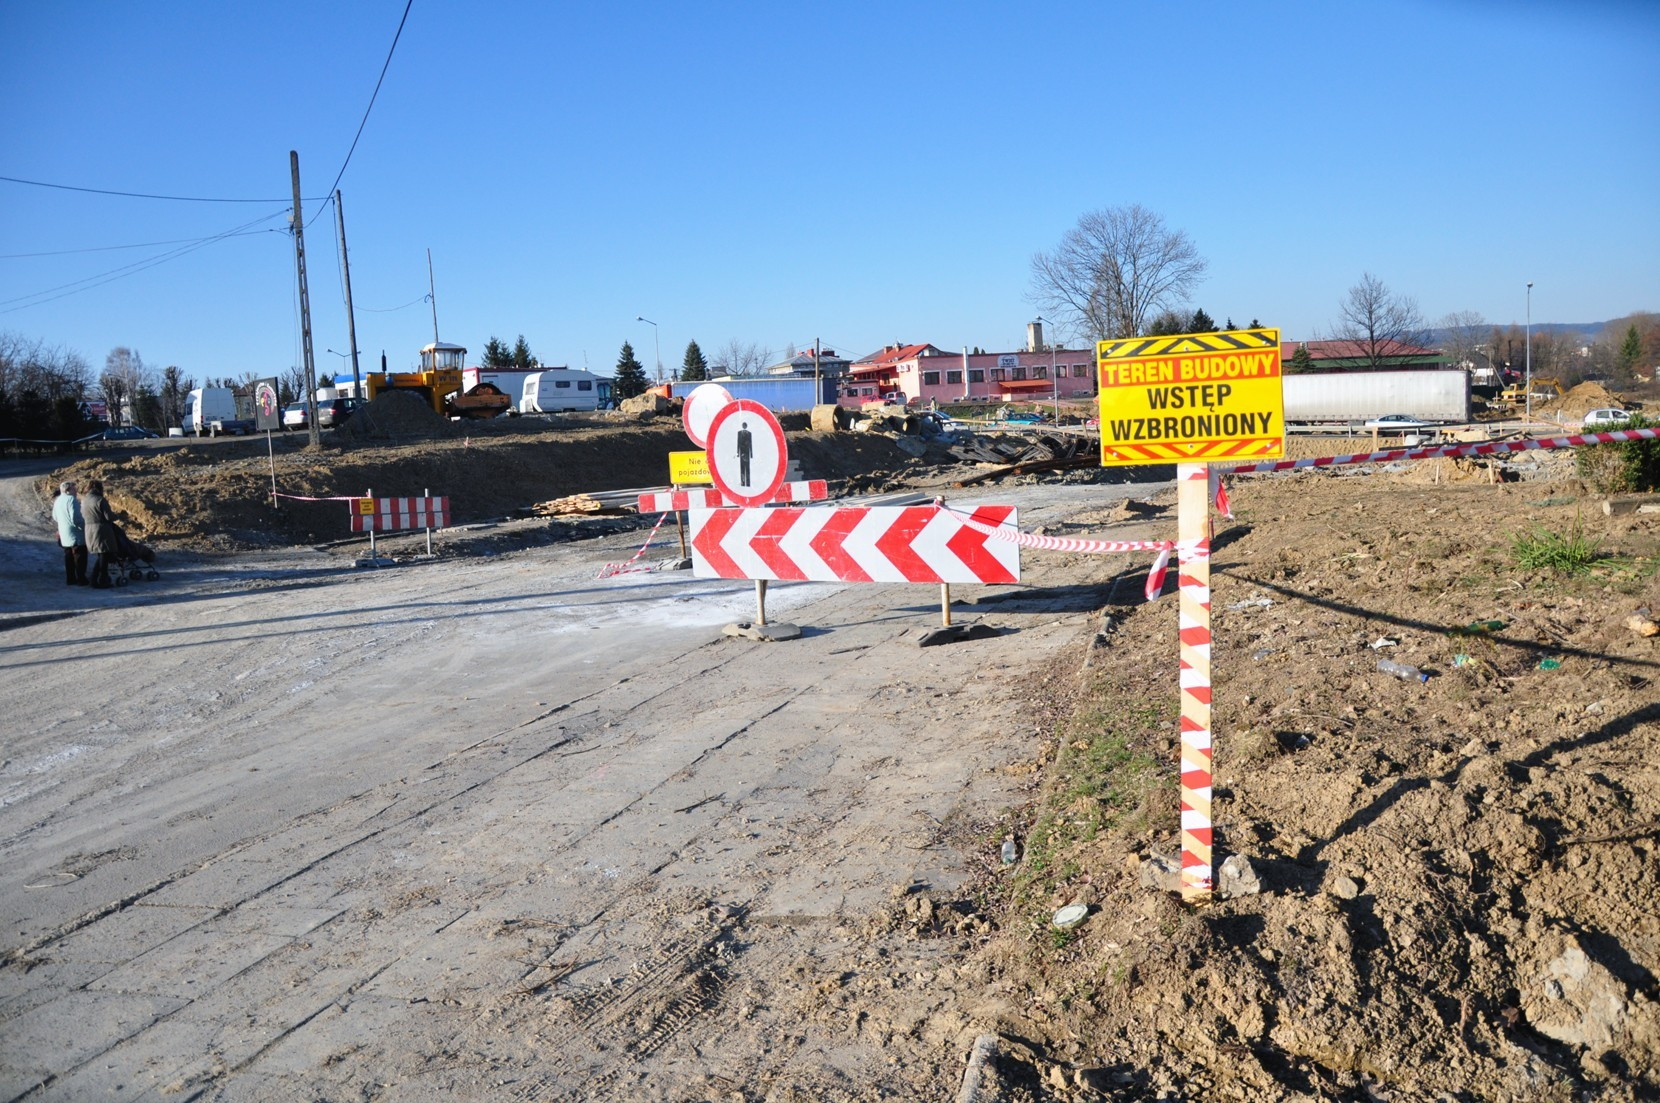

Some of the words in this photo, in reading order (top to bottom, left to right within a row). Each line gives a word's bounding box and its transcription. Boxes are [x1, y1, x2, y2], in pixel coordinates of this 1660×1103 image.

[1104, 360, 1174, 385] TEREN
[1180, 353, 1275, 380] BUDOWY
[1147, 384, 1232, 412] WSTĘP
[1110, 411, 1273, 441] WZBRONIONY
